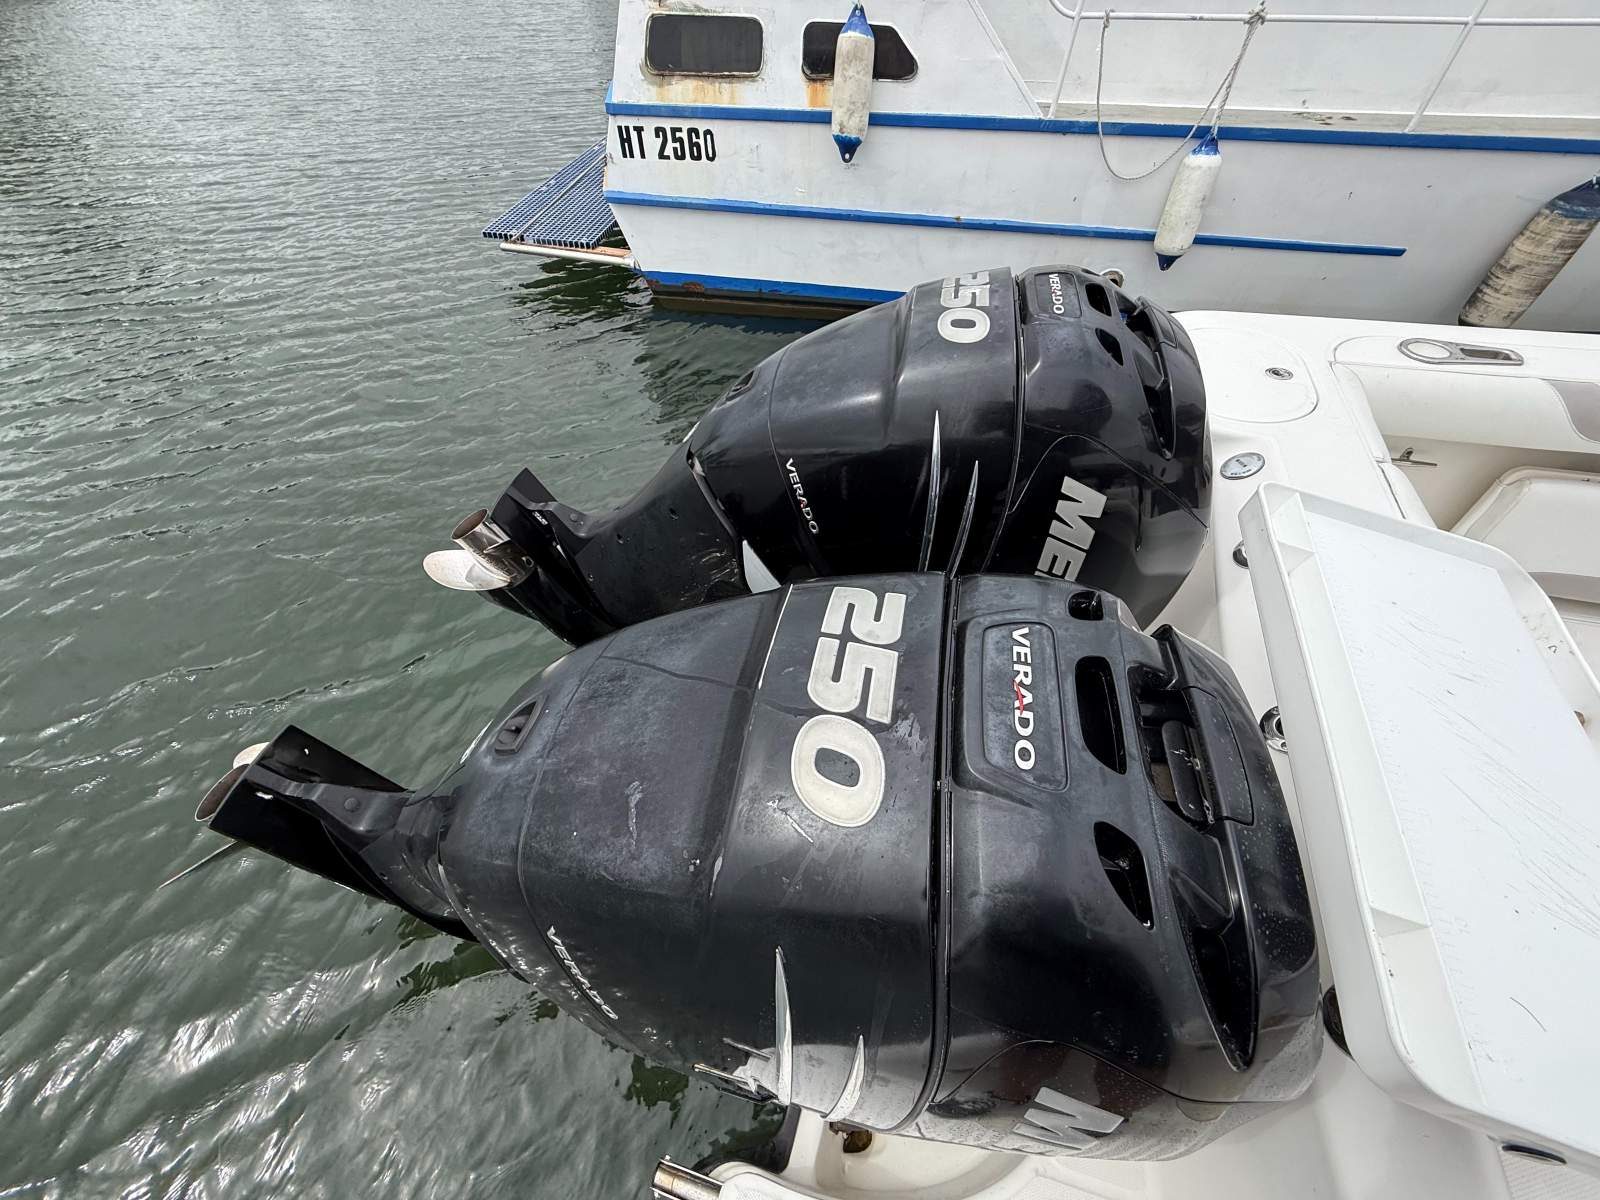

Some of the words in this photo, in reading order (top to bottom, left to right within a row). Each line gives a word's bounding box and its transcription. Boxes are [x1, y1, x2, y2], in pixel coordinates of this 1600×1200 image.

[617, 125, 646, 159] HT
[654, 126, 716, 162] 2560
[1048, 273, 1065, 315] VERADO
[786, 458, 819, 534] VERADO
[1034, 476, 1108, 581] ME
[791, 586, 907, 827] 250
[1011, 626, 1036, 771] VERADO
